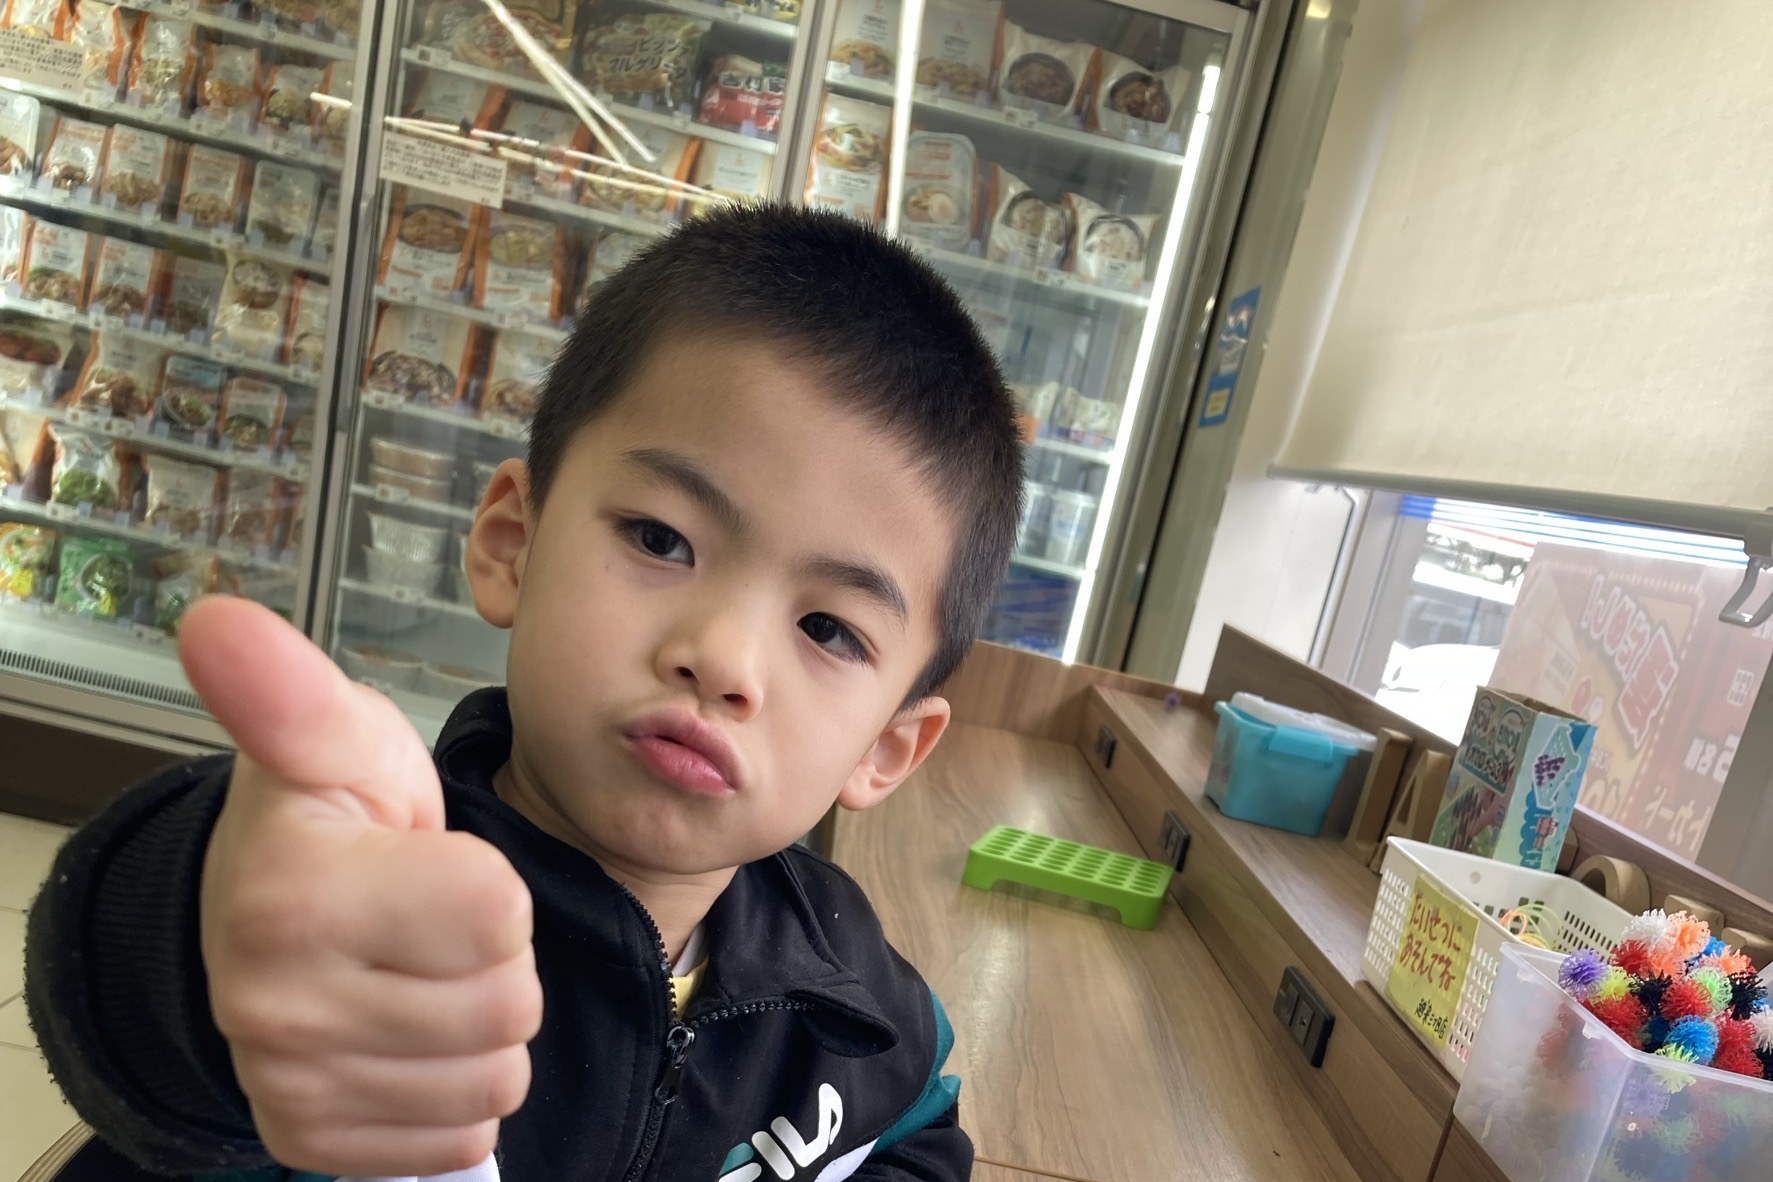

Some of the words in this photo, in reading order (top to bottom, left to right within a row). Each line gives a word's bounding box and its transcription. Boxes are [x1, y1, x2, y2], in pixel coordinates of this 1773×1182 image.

[608, 53, 687, 79] マルゲリータ
[1399, 933, 1456, 991] あそんでね
